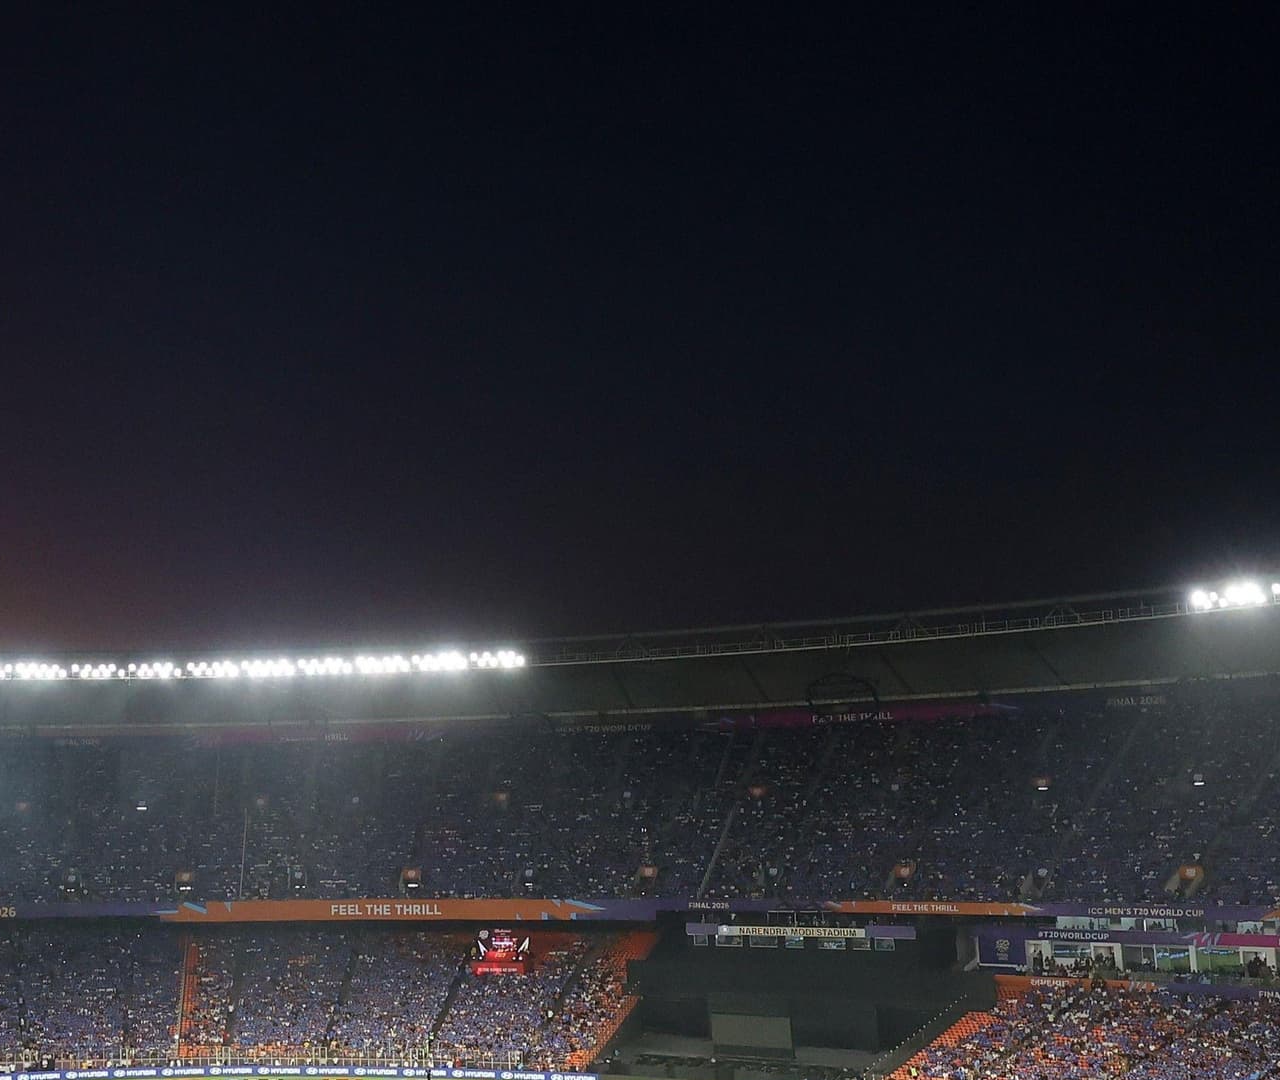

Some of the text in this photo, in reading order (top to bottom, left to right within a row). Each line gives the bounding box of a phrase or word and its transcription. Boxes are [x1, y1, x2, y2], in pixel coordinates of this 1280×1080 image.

[331, 904, 443, 916] FEEL THE THRILL
[688, 901, 711, 909] FINAL
[891, 903, 960, 912] FEEL THE THRILL
[1088, 907, 1205, 918] ICC MEN'S T20 WORLD CUP
[739, 927, 858, 937] NARENDRA MODI STADIUM
